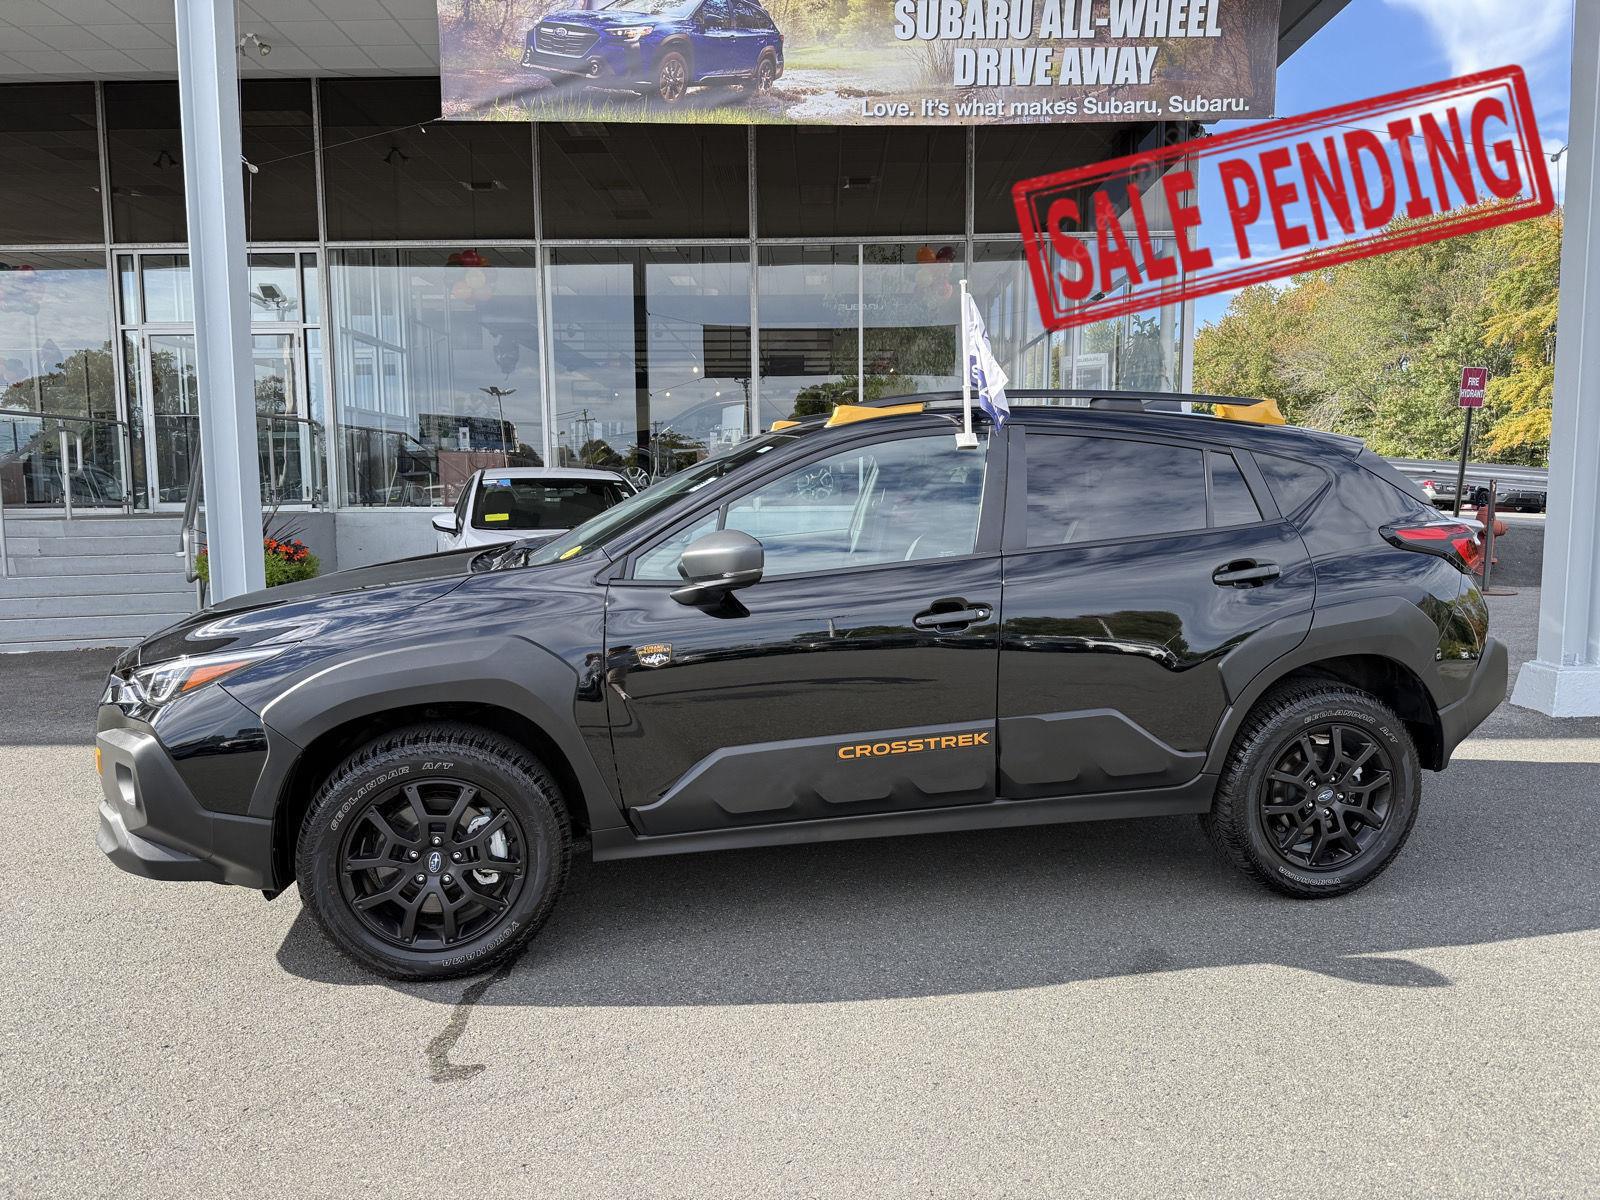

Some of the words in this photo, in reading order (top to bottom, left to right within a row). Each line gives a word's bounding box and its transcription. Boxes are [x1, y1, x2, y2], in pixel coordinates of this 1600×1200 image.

[893, 0, 1034, 40] SUBARU
[1038, 0, 1222, 38] ALL-WHEEL
[953, 47, 1053, 87] DRIVE
[1059, 46, 1159, 86] AWAY
[861, 99, 915, 117] Love.
[954, 98, 1004, 117] what
[1009, 97, 1078, 117] makes
[1083, 96, 1163, 116] Subaru,
[1168, 94, 1250, 113] Subaru.
[1460, 389, 1485, 398] HYDRANT
[1467, 377, 1480, 387] FIRE
[837, 732, 990, 760] CROSSTREK
[330, 765, 410, 831] GEOLANDAR
[422, 761, 454, 770] A/T
[1278, 865, 1342, 886] YOKOHAMA
[441, 920, 520, 967] YOKOHAMA
